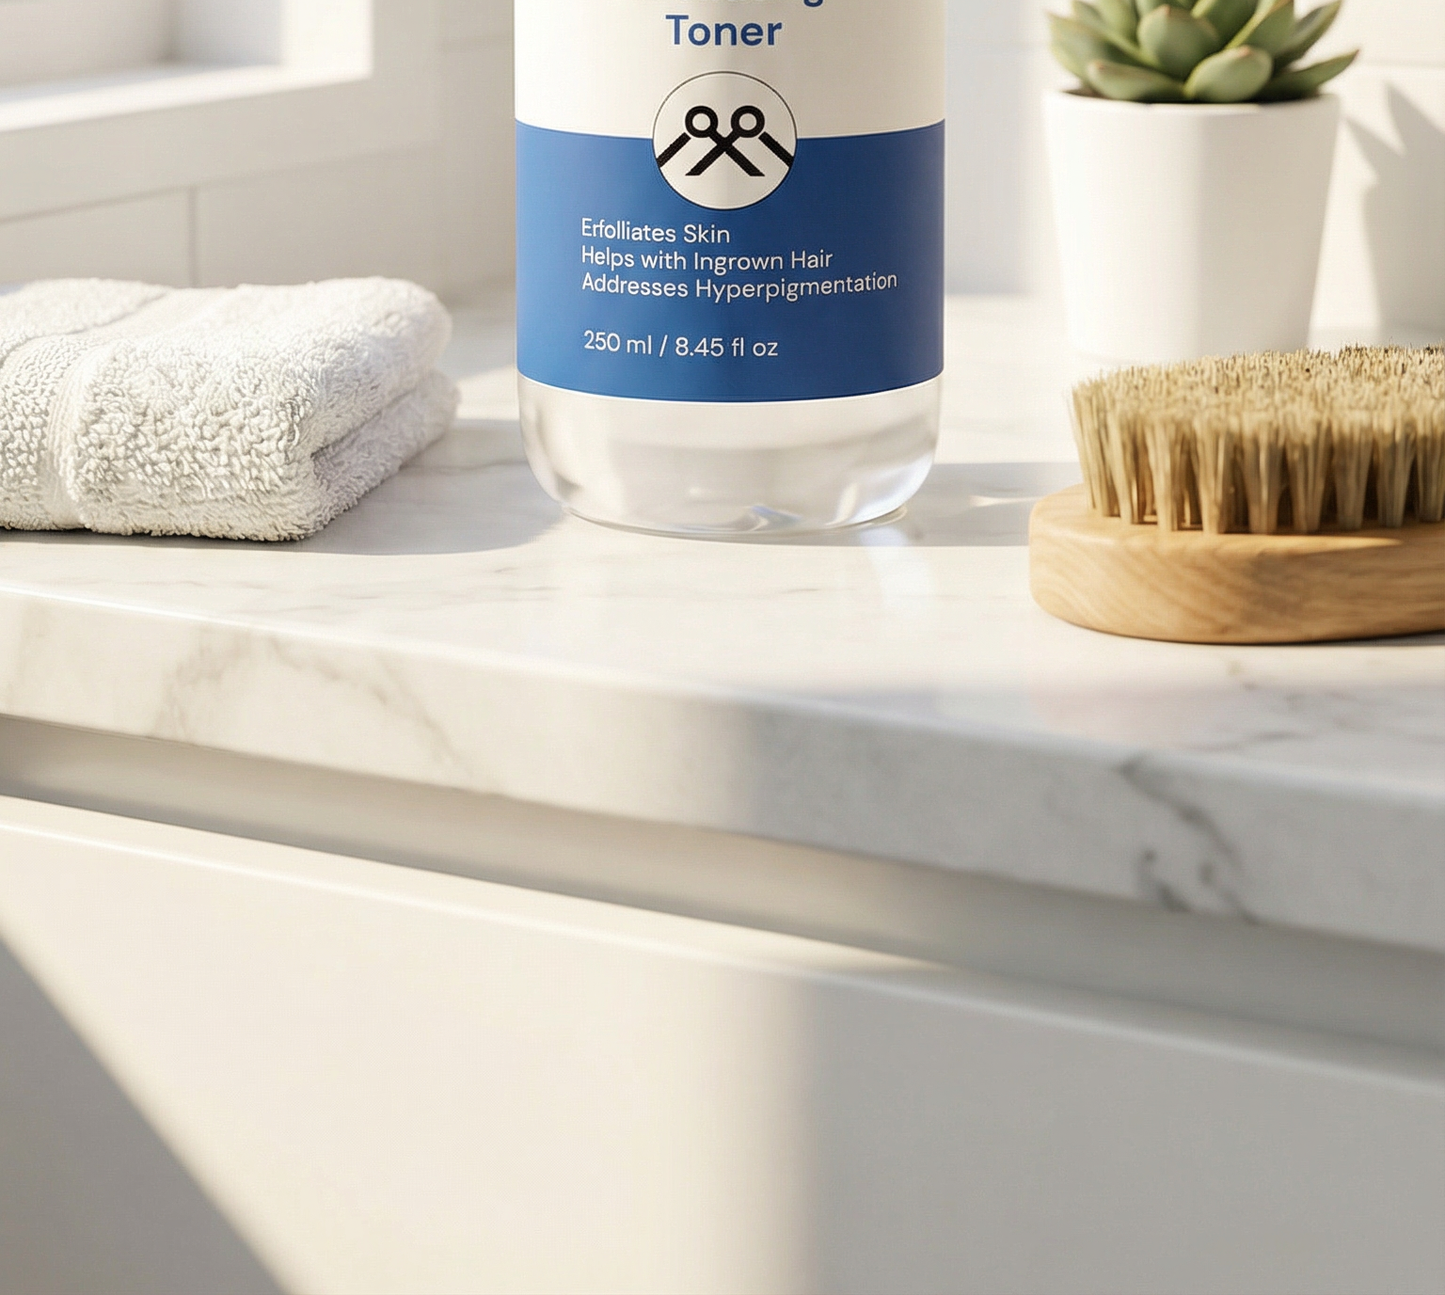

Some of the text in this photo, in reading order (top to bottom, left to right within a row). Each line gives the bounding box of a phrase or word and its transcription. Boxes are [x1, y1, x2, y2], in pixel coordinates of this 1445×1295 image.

[666, 15, 782, 46] Toner
[684, 224, 729, 243] Skin
[582, 245, 832, 275] Helps with Ingrown Hair
[582, 272, 896, 303] Addresses Hyperpigmentation
[585, 330, 778, 357] 250 ml / 8.45 fl oz
